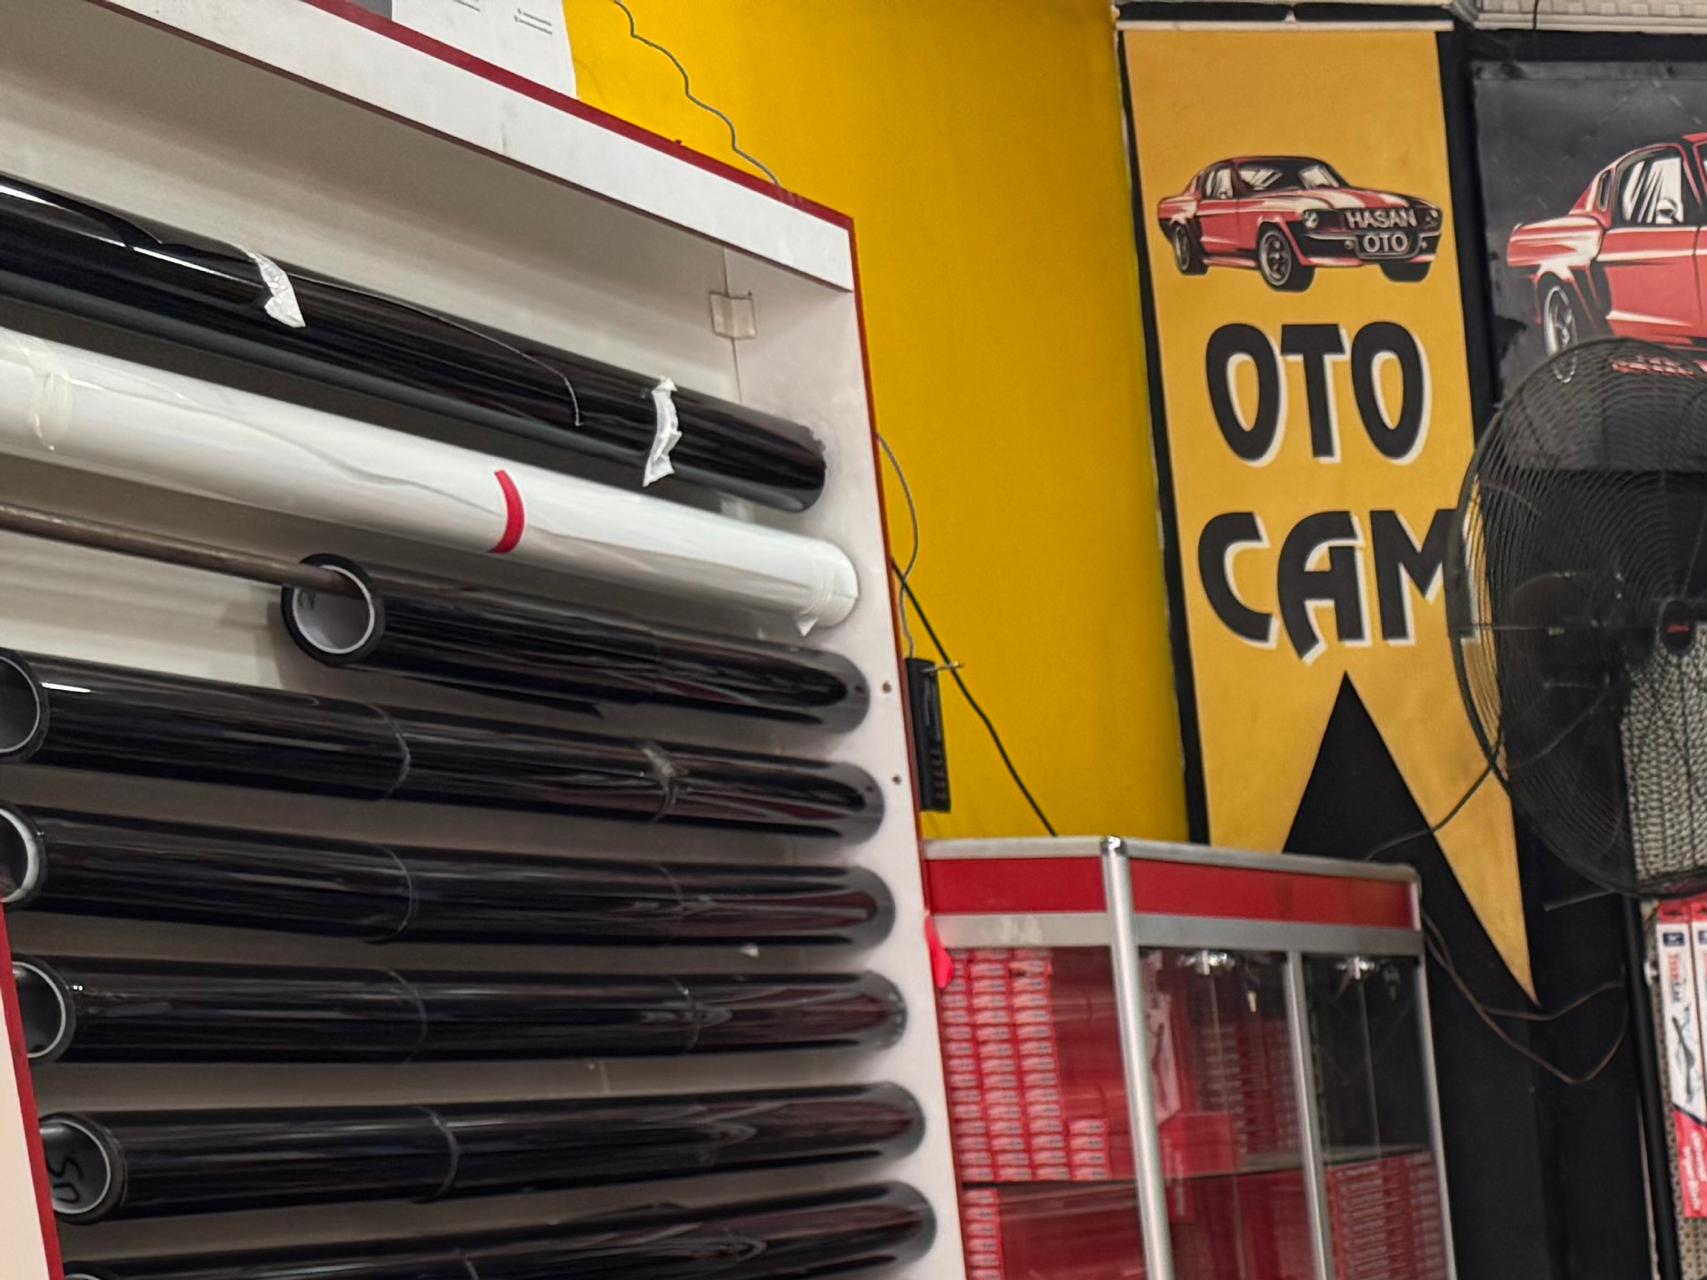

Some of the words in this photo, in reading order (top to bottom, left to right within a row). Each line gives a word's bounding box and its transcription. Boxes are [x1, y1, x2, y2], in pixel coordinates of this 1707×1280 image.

[1344, 208, 1417, 230] HASAN
[1362, 231, 1408, 253] OTO
[1206, 322, 1430, 464] OTO
[1198, 509, 1466, 665] CAM
